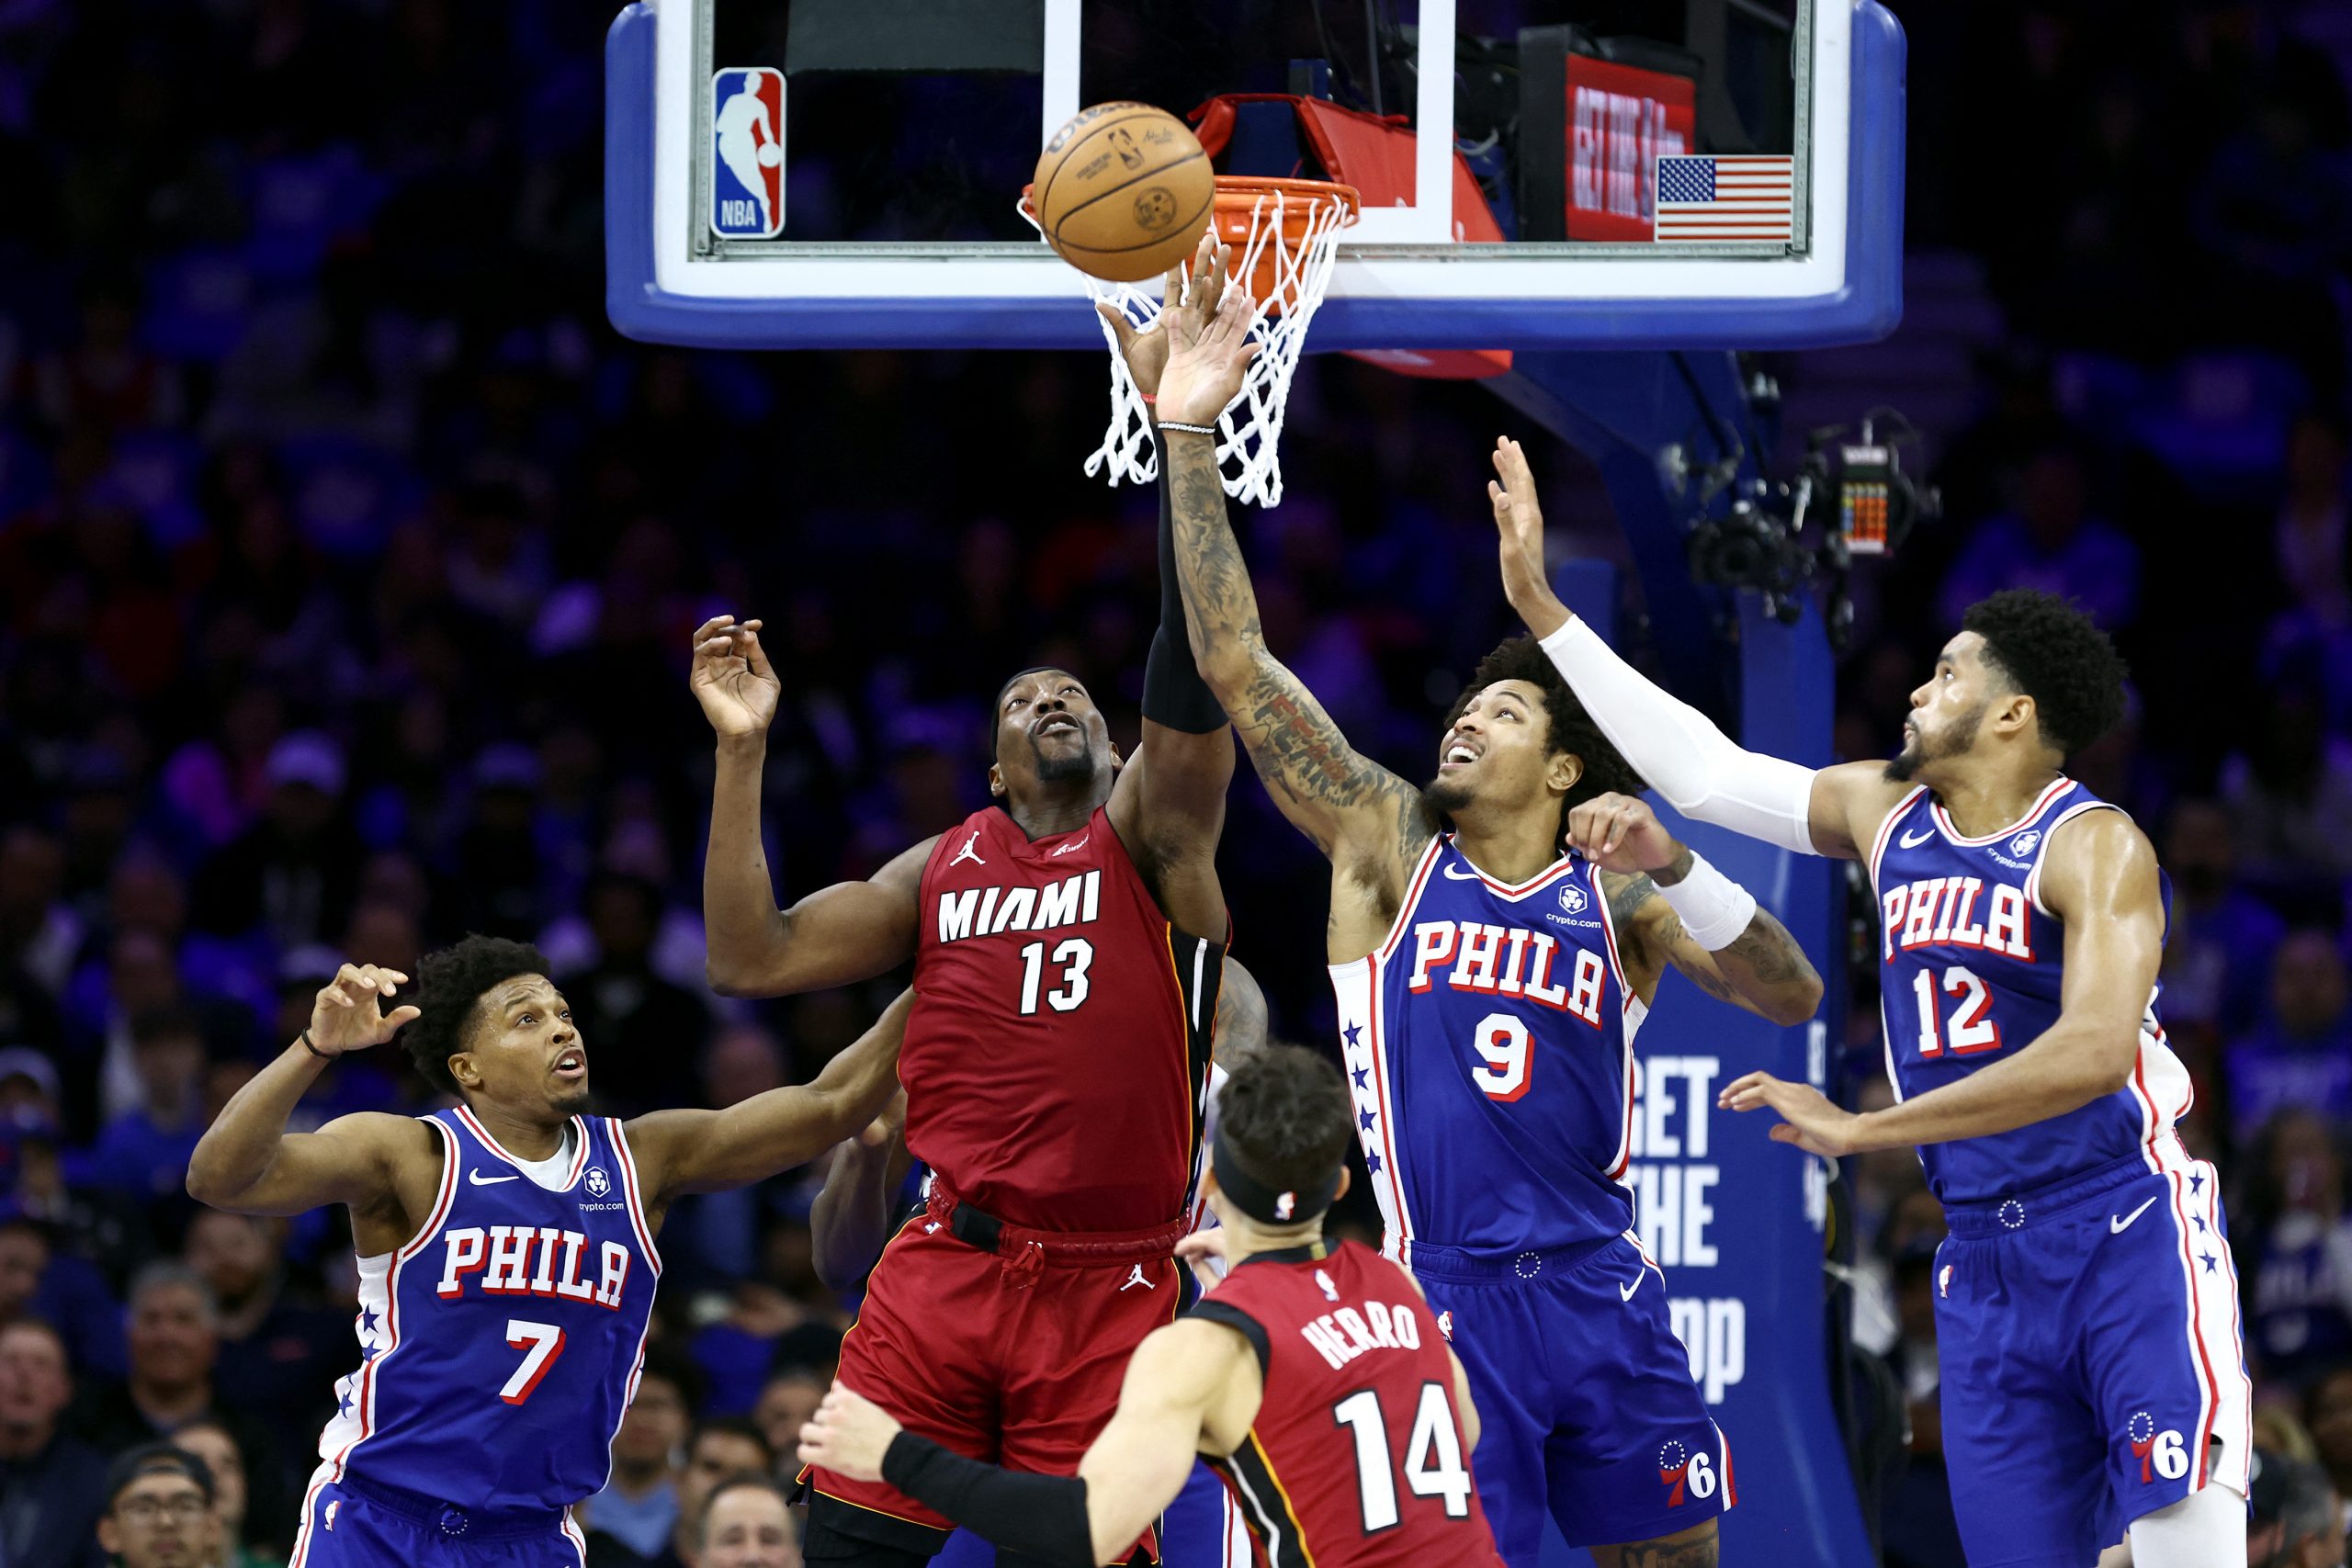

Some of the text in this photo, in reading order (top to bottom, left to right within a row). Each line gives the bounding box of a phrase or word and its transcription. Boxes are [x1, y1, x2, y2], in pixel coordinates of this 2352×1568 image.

[720, 199, 757, 227] NBA
[937, 869, 1102, 945] MIAMI
[1546, 913, 1602, 929] crypto.com
[1883, 876, 2036, 964] PHILA
[1019, 936, 1095, 1016] 13
[1408, 919, 1606, 1031] PHILA
[1912, 965, 2003, 1057] 12
[1472, 1012, 1535, 1102] 9
[435, 1225, 632, 1312] PHILA
[499, 1319, 566, 1405] 7
[1300, 1300, 1421, 1371] HERRO
[1668, 1296, 1746, 1405] pp
[1332, 1381, 1473, 1536] 14
[1659, 1451, 1716, 1508] 76
[2131, 1430, 2189, 1483] 76
